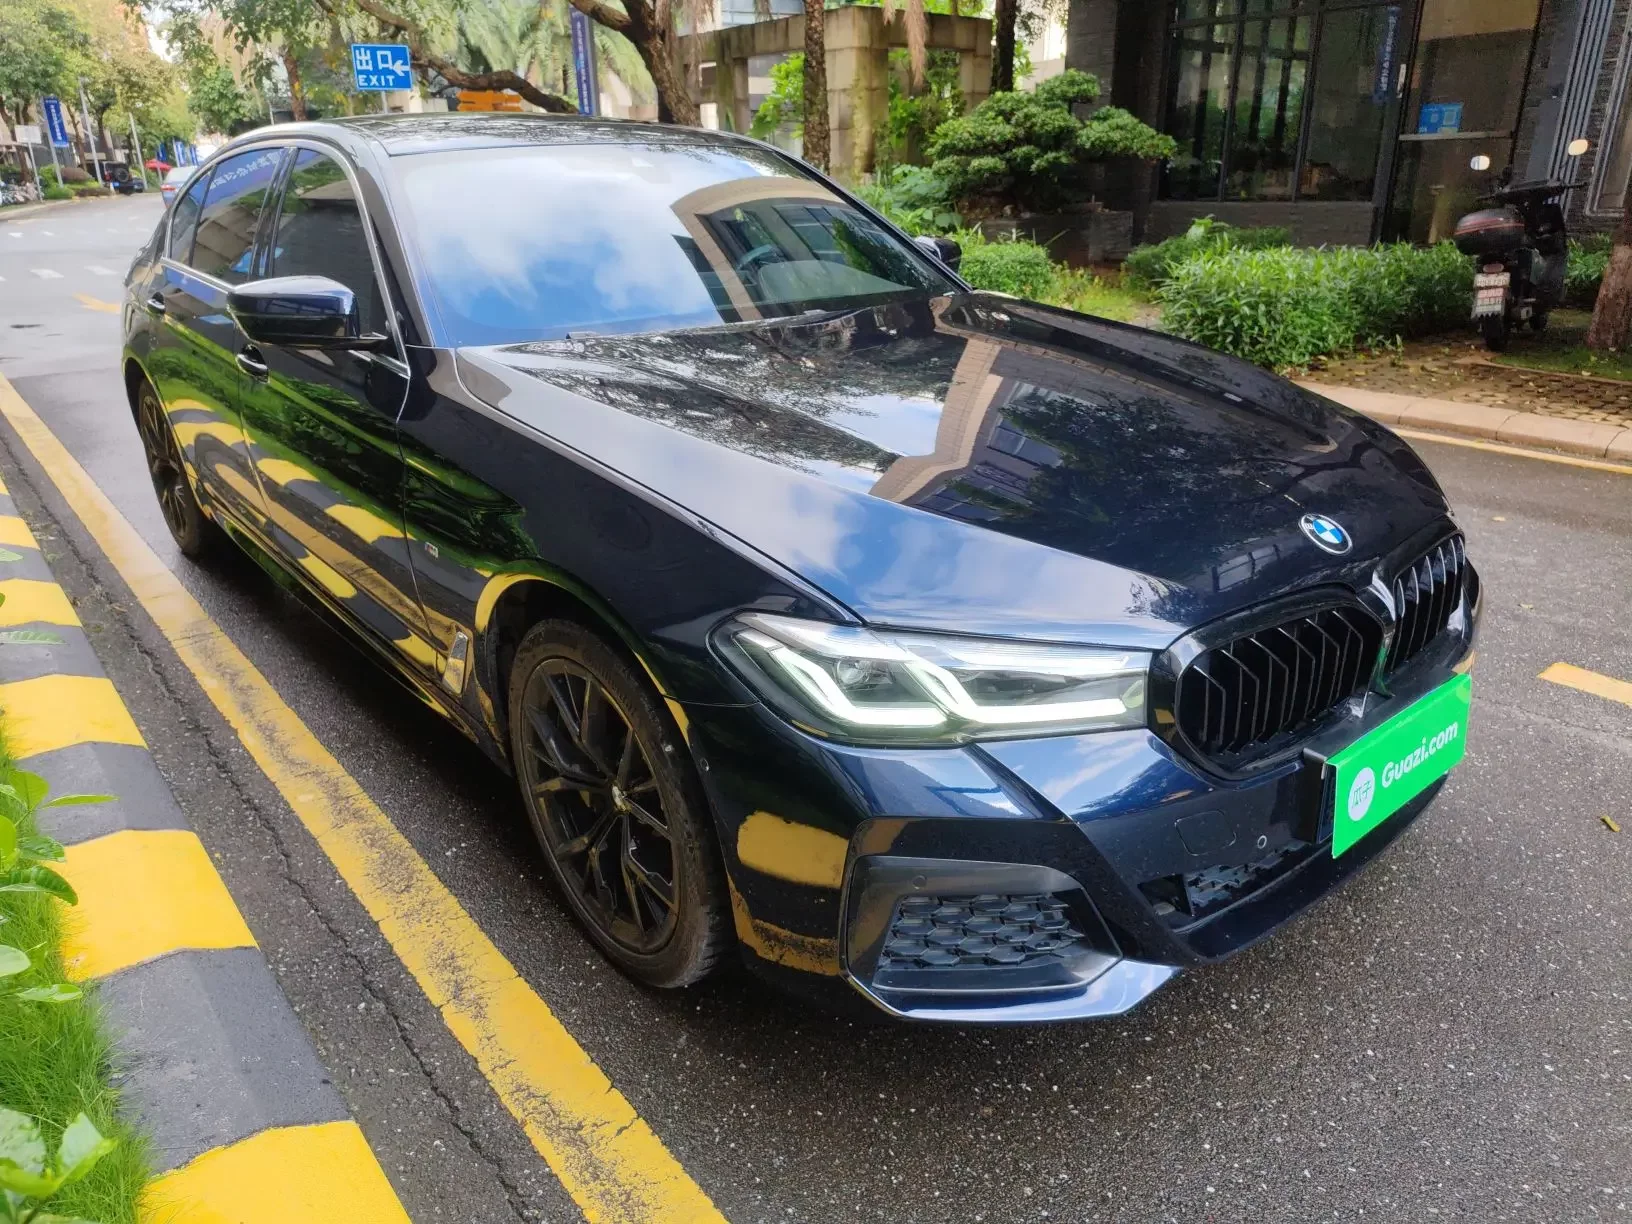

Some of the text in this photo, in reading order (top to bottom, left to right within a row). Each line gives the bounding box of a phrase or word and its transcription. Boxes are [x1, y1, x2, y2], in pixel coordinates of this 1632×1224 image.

[355, 47, 393, 71] 出口
[358, 75, 395, 86] EXIT
[1381, 721, 1458, 788] Guazi.com
